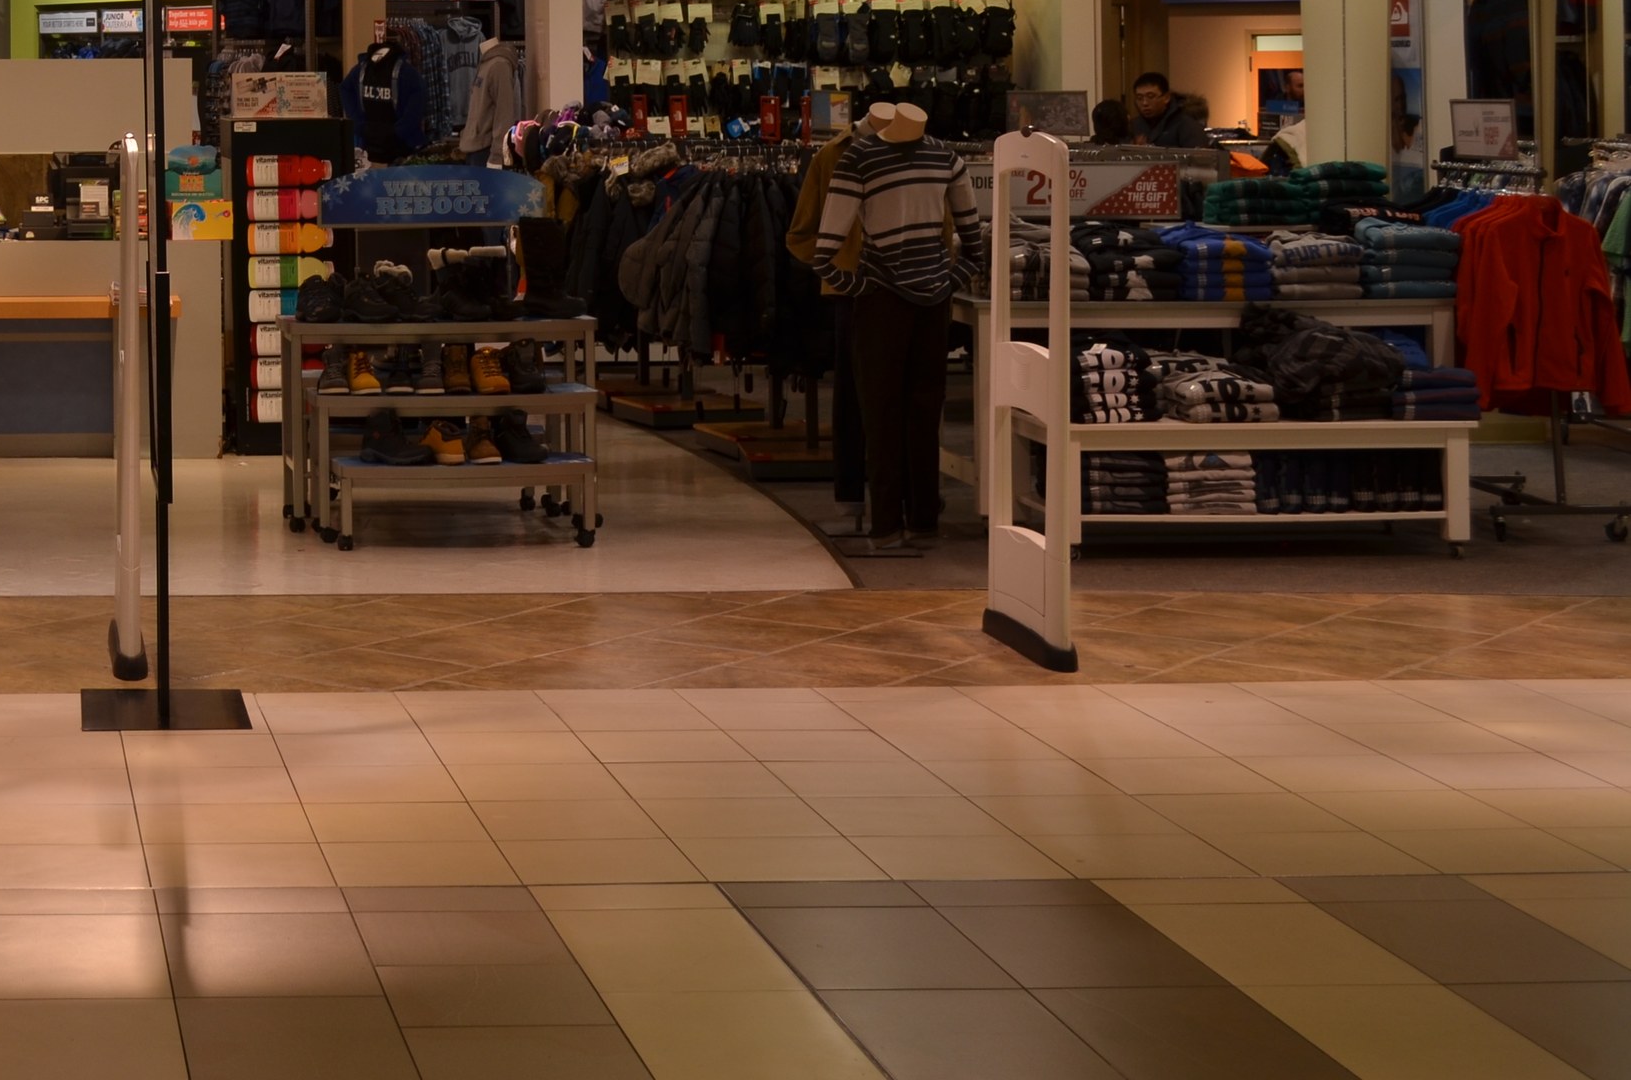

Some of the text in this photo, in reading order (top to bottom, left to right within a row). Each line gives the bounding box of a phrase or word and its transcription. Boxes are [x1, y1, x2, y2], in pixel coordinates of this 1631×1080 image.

[383, 180, 481, 197] WINTER
[1135, 181, 1158, 192] GIVE
[35, 196, 49, 204] SPC
[1127, 192, 1168, 202] THE GIFT
[376, 195, 489, 215] REBOOT
